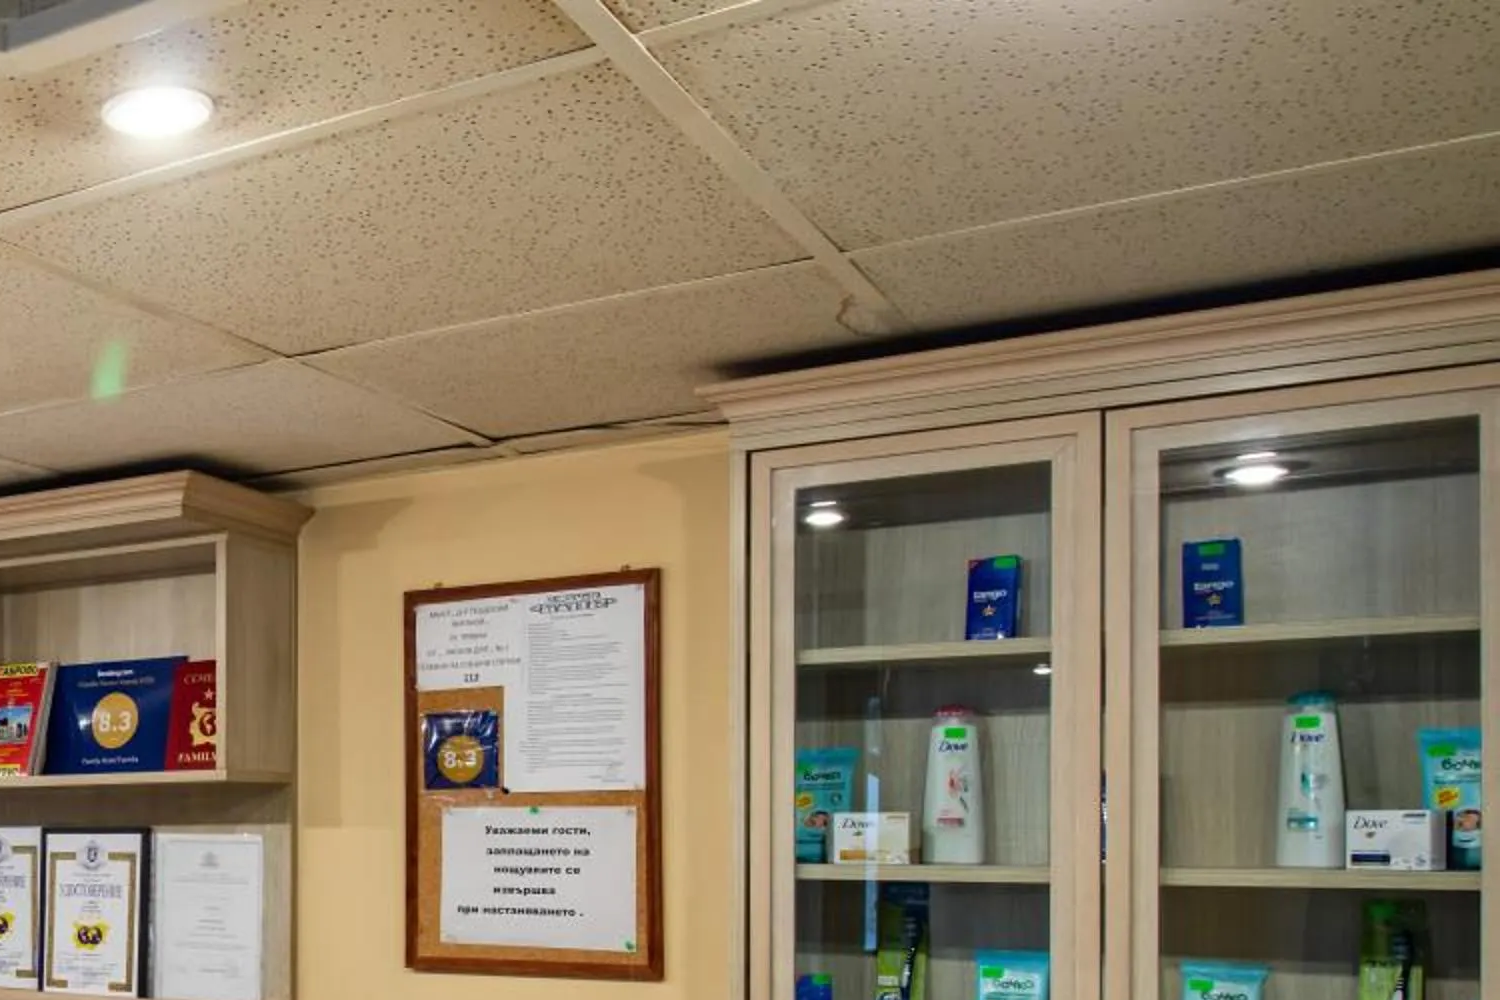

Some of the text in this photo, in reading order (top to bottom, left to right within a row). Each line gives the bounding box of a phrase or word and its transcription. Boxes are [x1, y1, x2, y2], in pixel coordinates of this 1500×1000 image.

[99, 711, 133, 733] 8.3
[1291, 732, 1325, 744] Dove
[938, 741, 969, 753] Dove
[443, 750, 477, 769] 8.3
[1353, 815, 1388, 830] Dove
[485, 825, 591, 837] Уважаеми гости,
[486, 847, 591, 858] заплащането на
[493, 866, 581, 877] нощувките се
[493, 887, 557, 896] извършва
[457, 906, 479, 915] при
